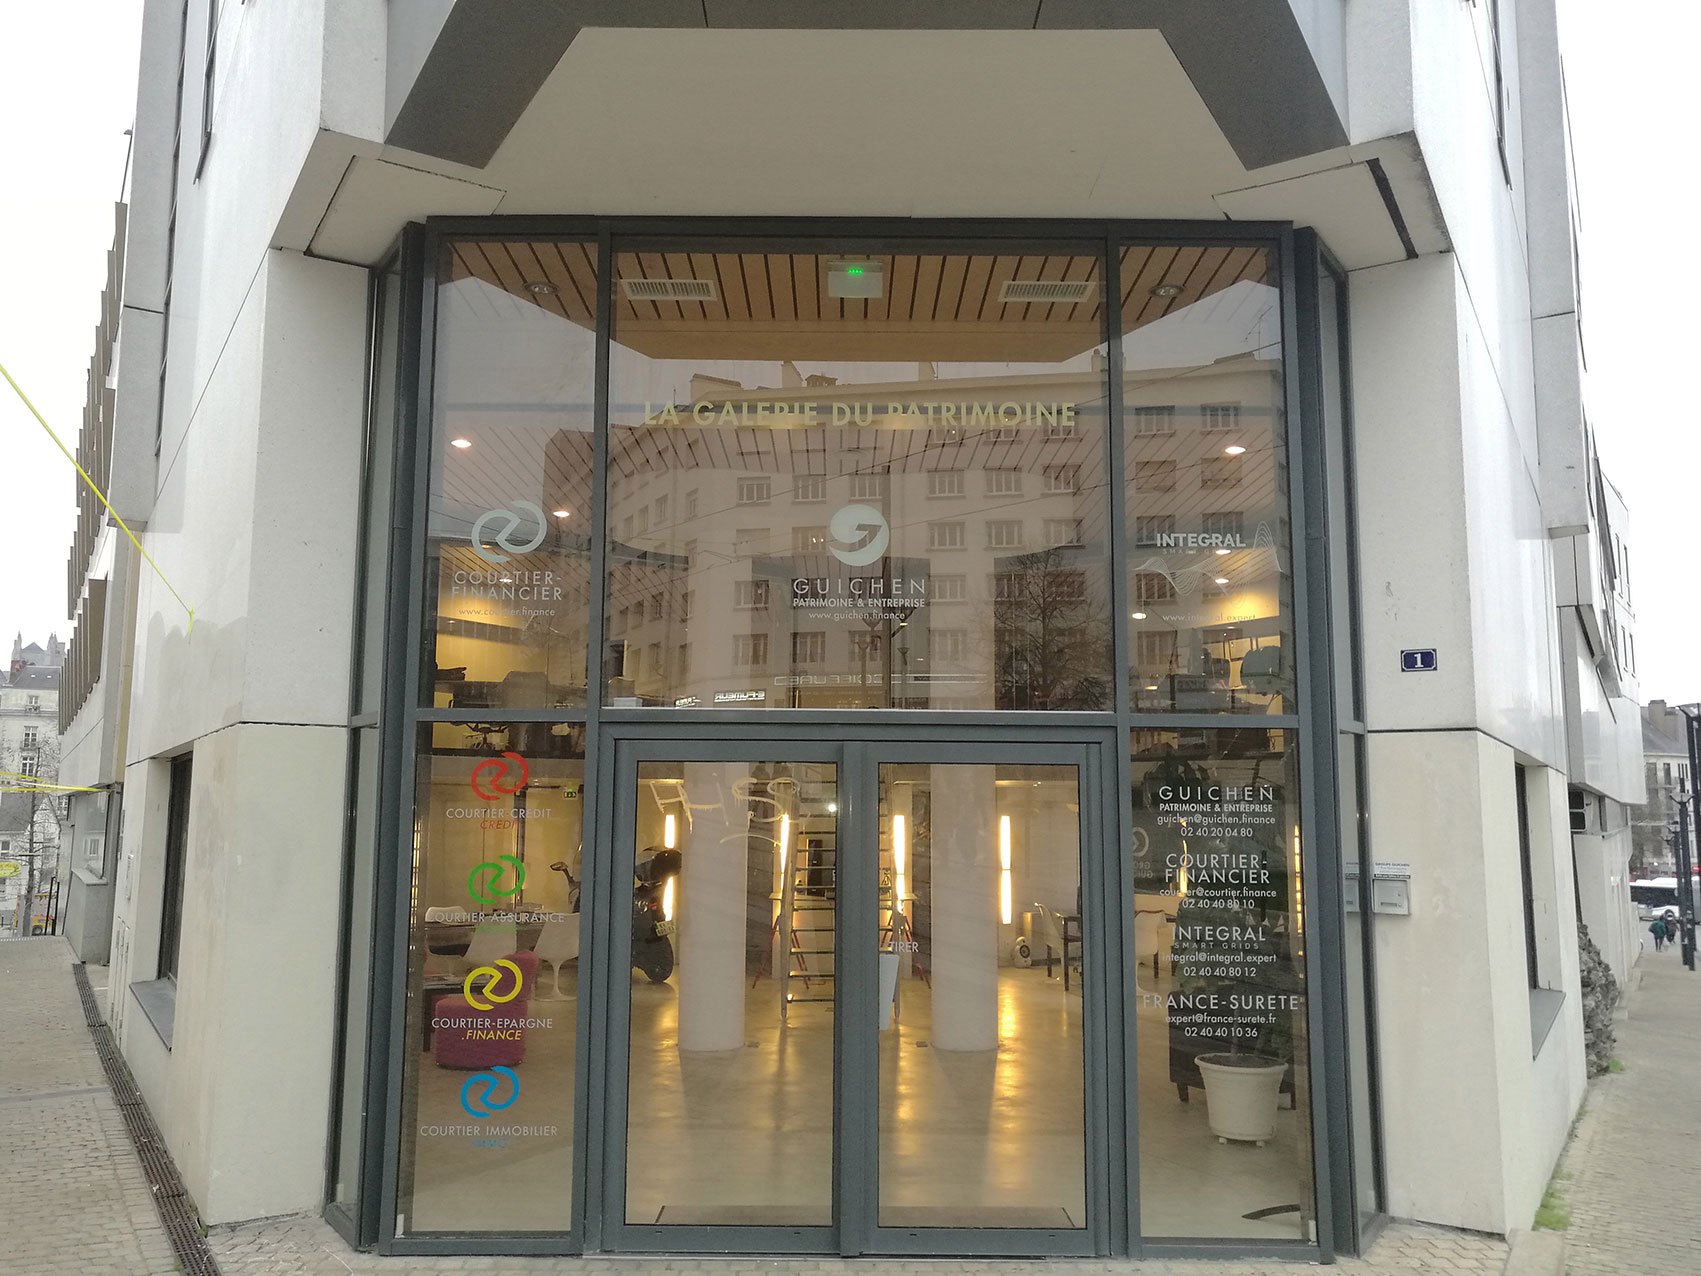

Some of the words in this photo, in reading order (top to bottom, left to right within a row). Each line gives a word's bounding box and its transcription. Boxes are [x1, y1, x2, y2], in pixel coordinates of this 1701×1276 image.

[644, 402, 680, 425] LA
[692, 402, 818, 426] GALERIE
[832, 402, 873, 426] DU
[888, 402, 1076, 426] PATRIMOINE
[1156, 533, 1247, 547] INTEGRAL
[793, 578, 926, 594] GUICHEN
[451, 586, 563, 601] FINANCIER
[793, 598, 854, 608] PATRIMOINE
[857, 599, 865, 607] &
[868, 598, 925, 608] ENTREPRISE
[458, 607, 556, 617] www.coer.finance
[808, 610, 906, 622] www.guichen.finance
[1414, 653, 1424, 668] 1
[1158, 786, 1274, 801] GUICHEN
[1159, 803, 1212, 812] PATRIMOINE
[1214, 804, 1221, 812] &
[1223, 803, 1273, 813] ENTREPRISE
[1157, 814, 1276, 826] guichen@guichen.finance
[1180, 827, 1193, 837] 02
[1196, 827, 1208, 837] 40
[1211, 827, 1223, 837] 20
[1225, 827, 1238, 837] 04
[1240, 828, 1253, 837] 80
[1166, 854, 1267, 869] COURTIER-
[1165, 869, 1270, 884] FINANCIER
[1159, 886, 1277, 898] courer@courtier.finance
[1182, 900, 1196, 909] 02
[1198, 900, 1210, 909] 40
[1213, 900, 1225, 909] 40
[1227, 900, 1239, 909] 80
[1243, 900, 1255, 909] 10
[491, 912, 565, 923] ASSURANCE
[1172, 926, 1266, 941] INTEGRAL
[888, 941, 919, 952] TIRER
[1163, 952, 1277, 965] integral@integral.expert
[1184, 967, 1196, 976] 02
[1199, 967, 1211, 976] 40
[1214, 967, 1226, 976] 40
[1229, 968, 1241, 976] 80
[1245, 968, 1256, 977] 12
[431, 1018, 553, 1029] COURTIER-EPARGNE
[1166, 1013, 1276, 1024] expert@france-surete.fr
[461, 1030, 522, 1041] .FINANCE
[1185, 1027, 1197, 1037] 02
[1200, 1027, 1212, 1037] 40
[1215, 1027, 1228, 1037] 40
[1232, 1027, 1243, 1037] 10
[1245, 1027, 1258, 1037] 36
[420, 1125, 480, 1137] COURTIER
[486, 1126, 558, 1137] IMMOBILIER
